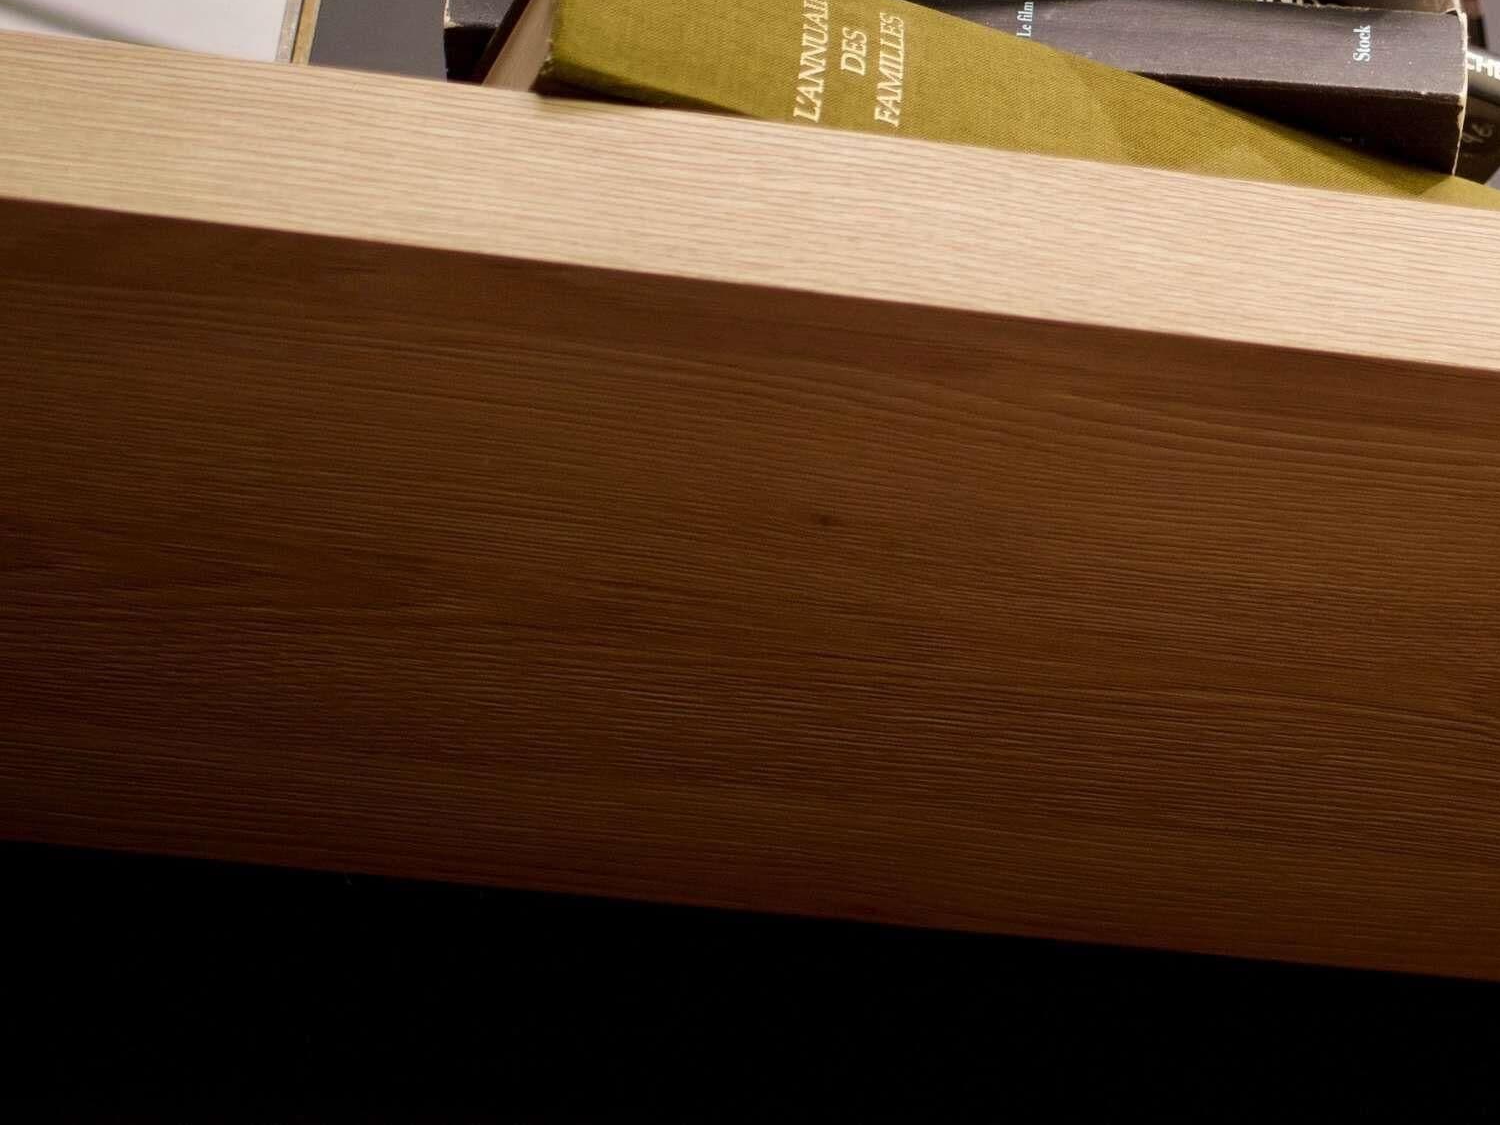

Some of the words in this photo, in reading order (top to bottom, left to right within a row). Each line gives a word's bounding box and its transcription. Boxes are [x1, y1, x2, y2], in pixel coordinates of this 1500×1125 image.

[1016, 1, 1034, 22] film
[1015, 24, 1032, 38] Le
[1352, 24, 1371, 62] Stock
[840, 26, 868, 76] DES
[873, 12, 905, 128] FAMILLES
